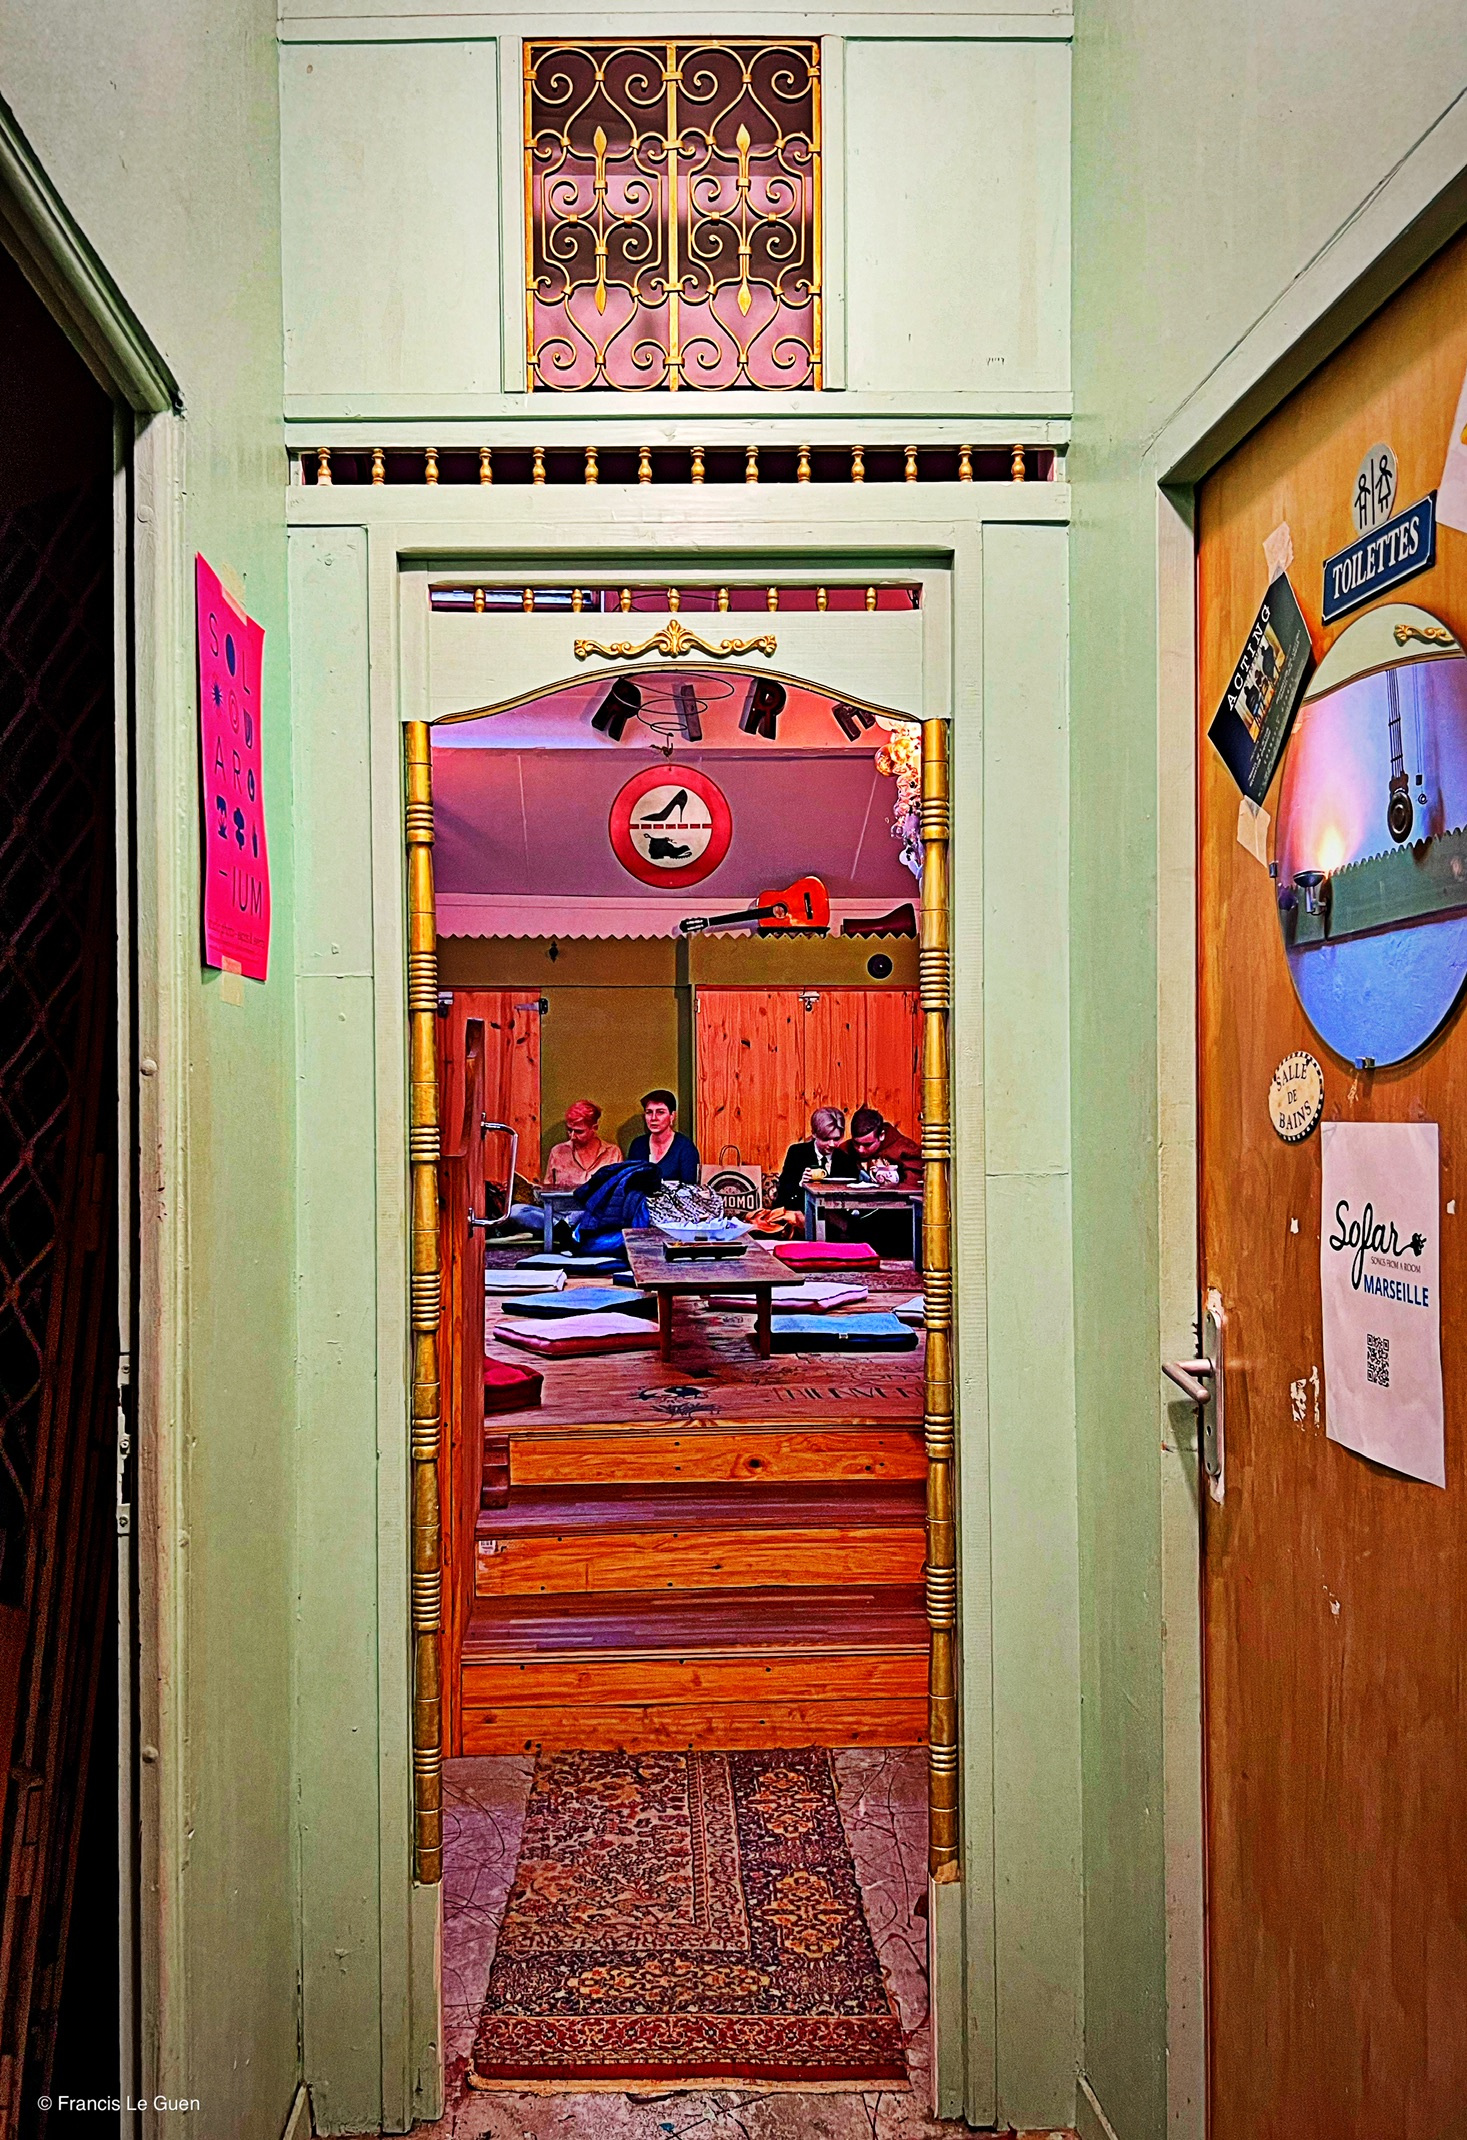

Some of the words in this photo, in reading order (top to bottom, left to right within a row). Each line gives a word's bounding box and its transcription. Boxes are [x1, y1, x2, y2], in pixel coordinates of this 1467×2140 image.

[1332, 516, 1420, 600] TOILETTES
[1227, 604, 1271, 712] ACTING
[1275, 1063, 1308, 1092] SALLE
[1287, 1089, 1298, 1105] DE
[1279, 1100, 1313, 1130] BAINS
[1329, 1199, 1403, 1290] Sofar
[1363, 1273, 1429, 1308] MARSEILLE
